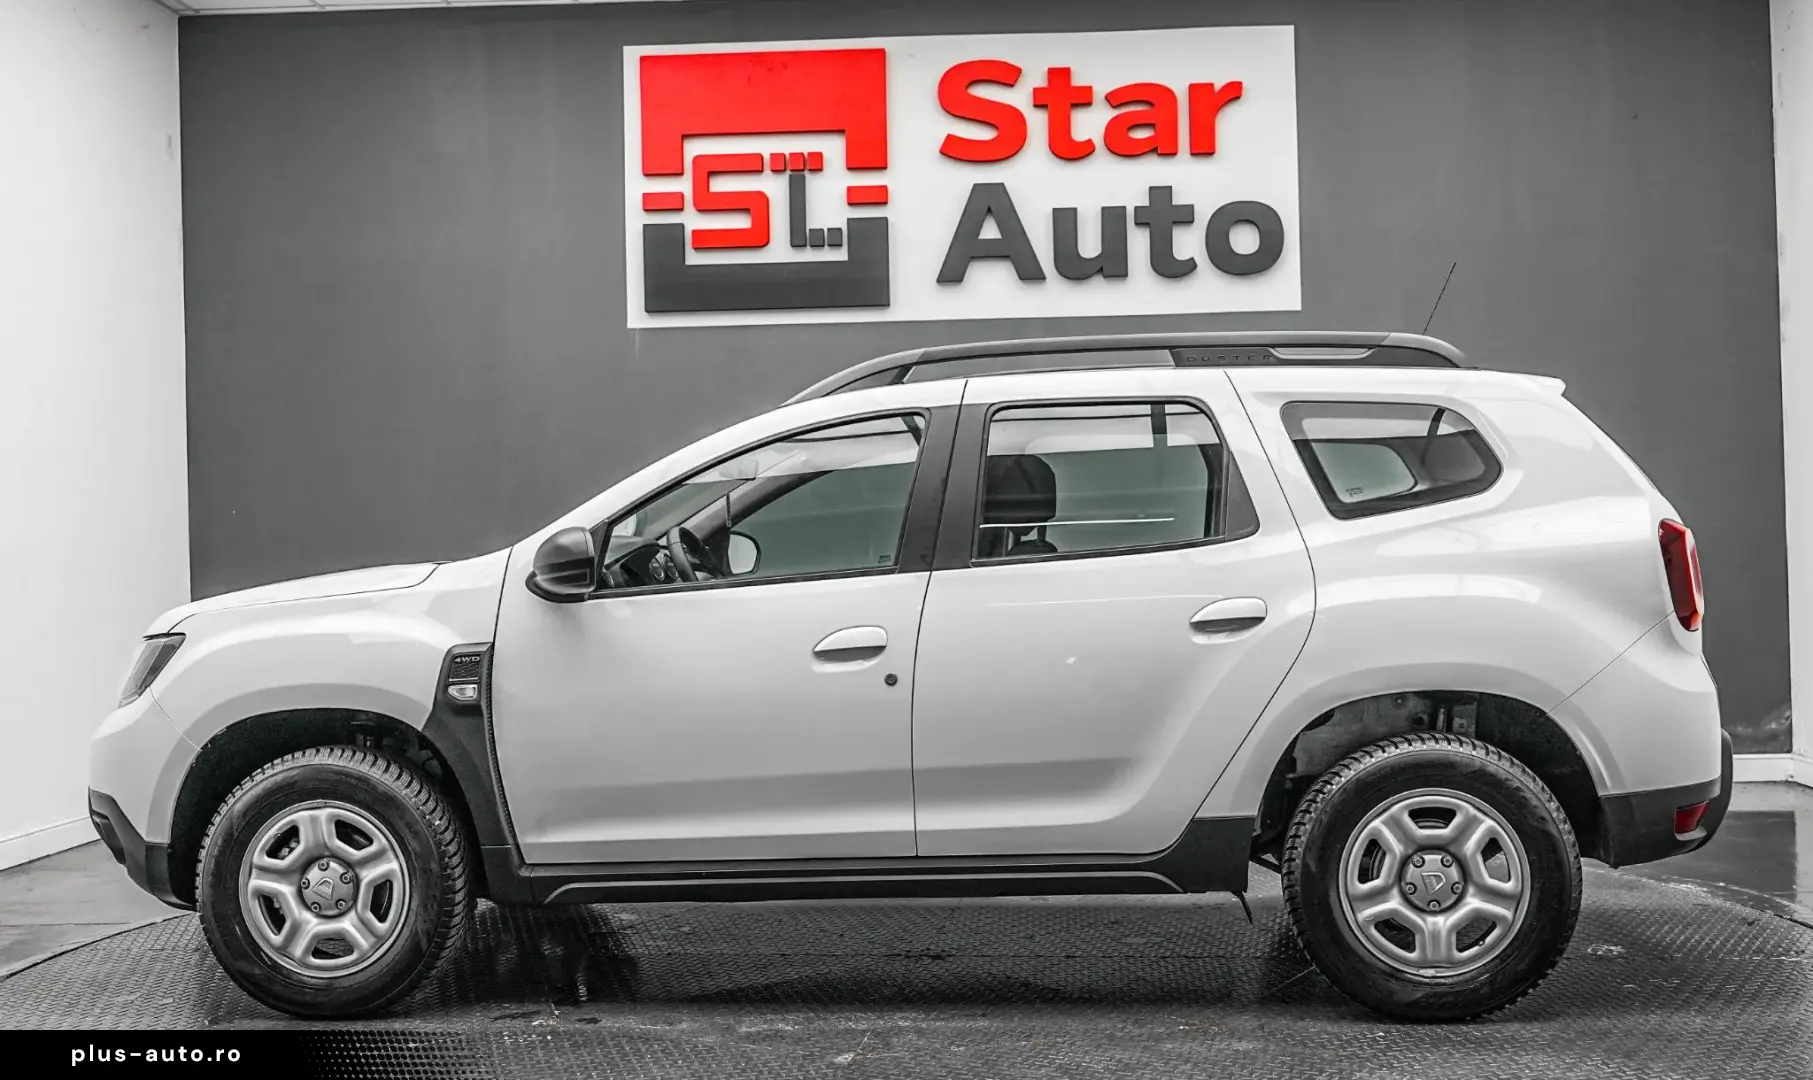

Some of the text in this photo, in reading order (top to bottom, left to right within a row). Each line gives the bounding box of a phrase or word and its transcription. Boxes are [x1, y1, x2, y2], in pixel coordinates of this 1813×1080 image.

[937, 59, 1243, 163] Star
[936, 182, 1285, 283] Auto
[1186, 353, 1272, 362] DUSTER
